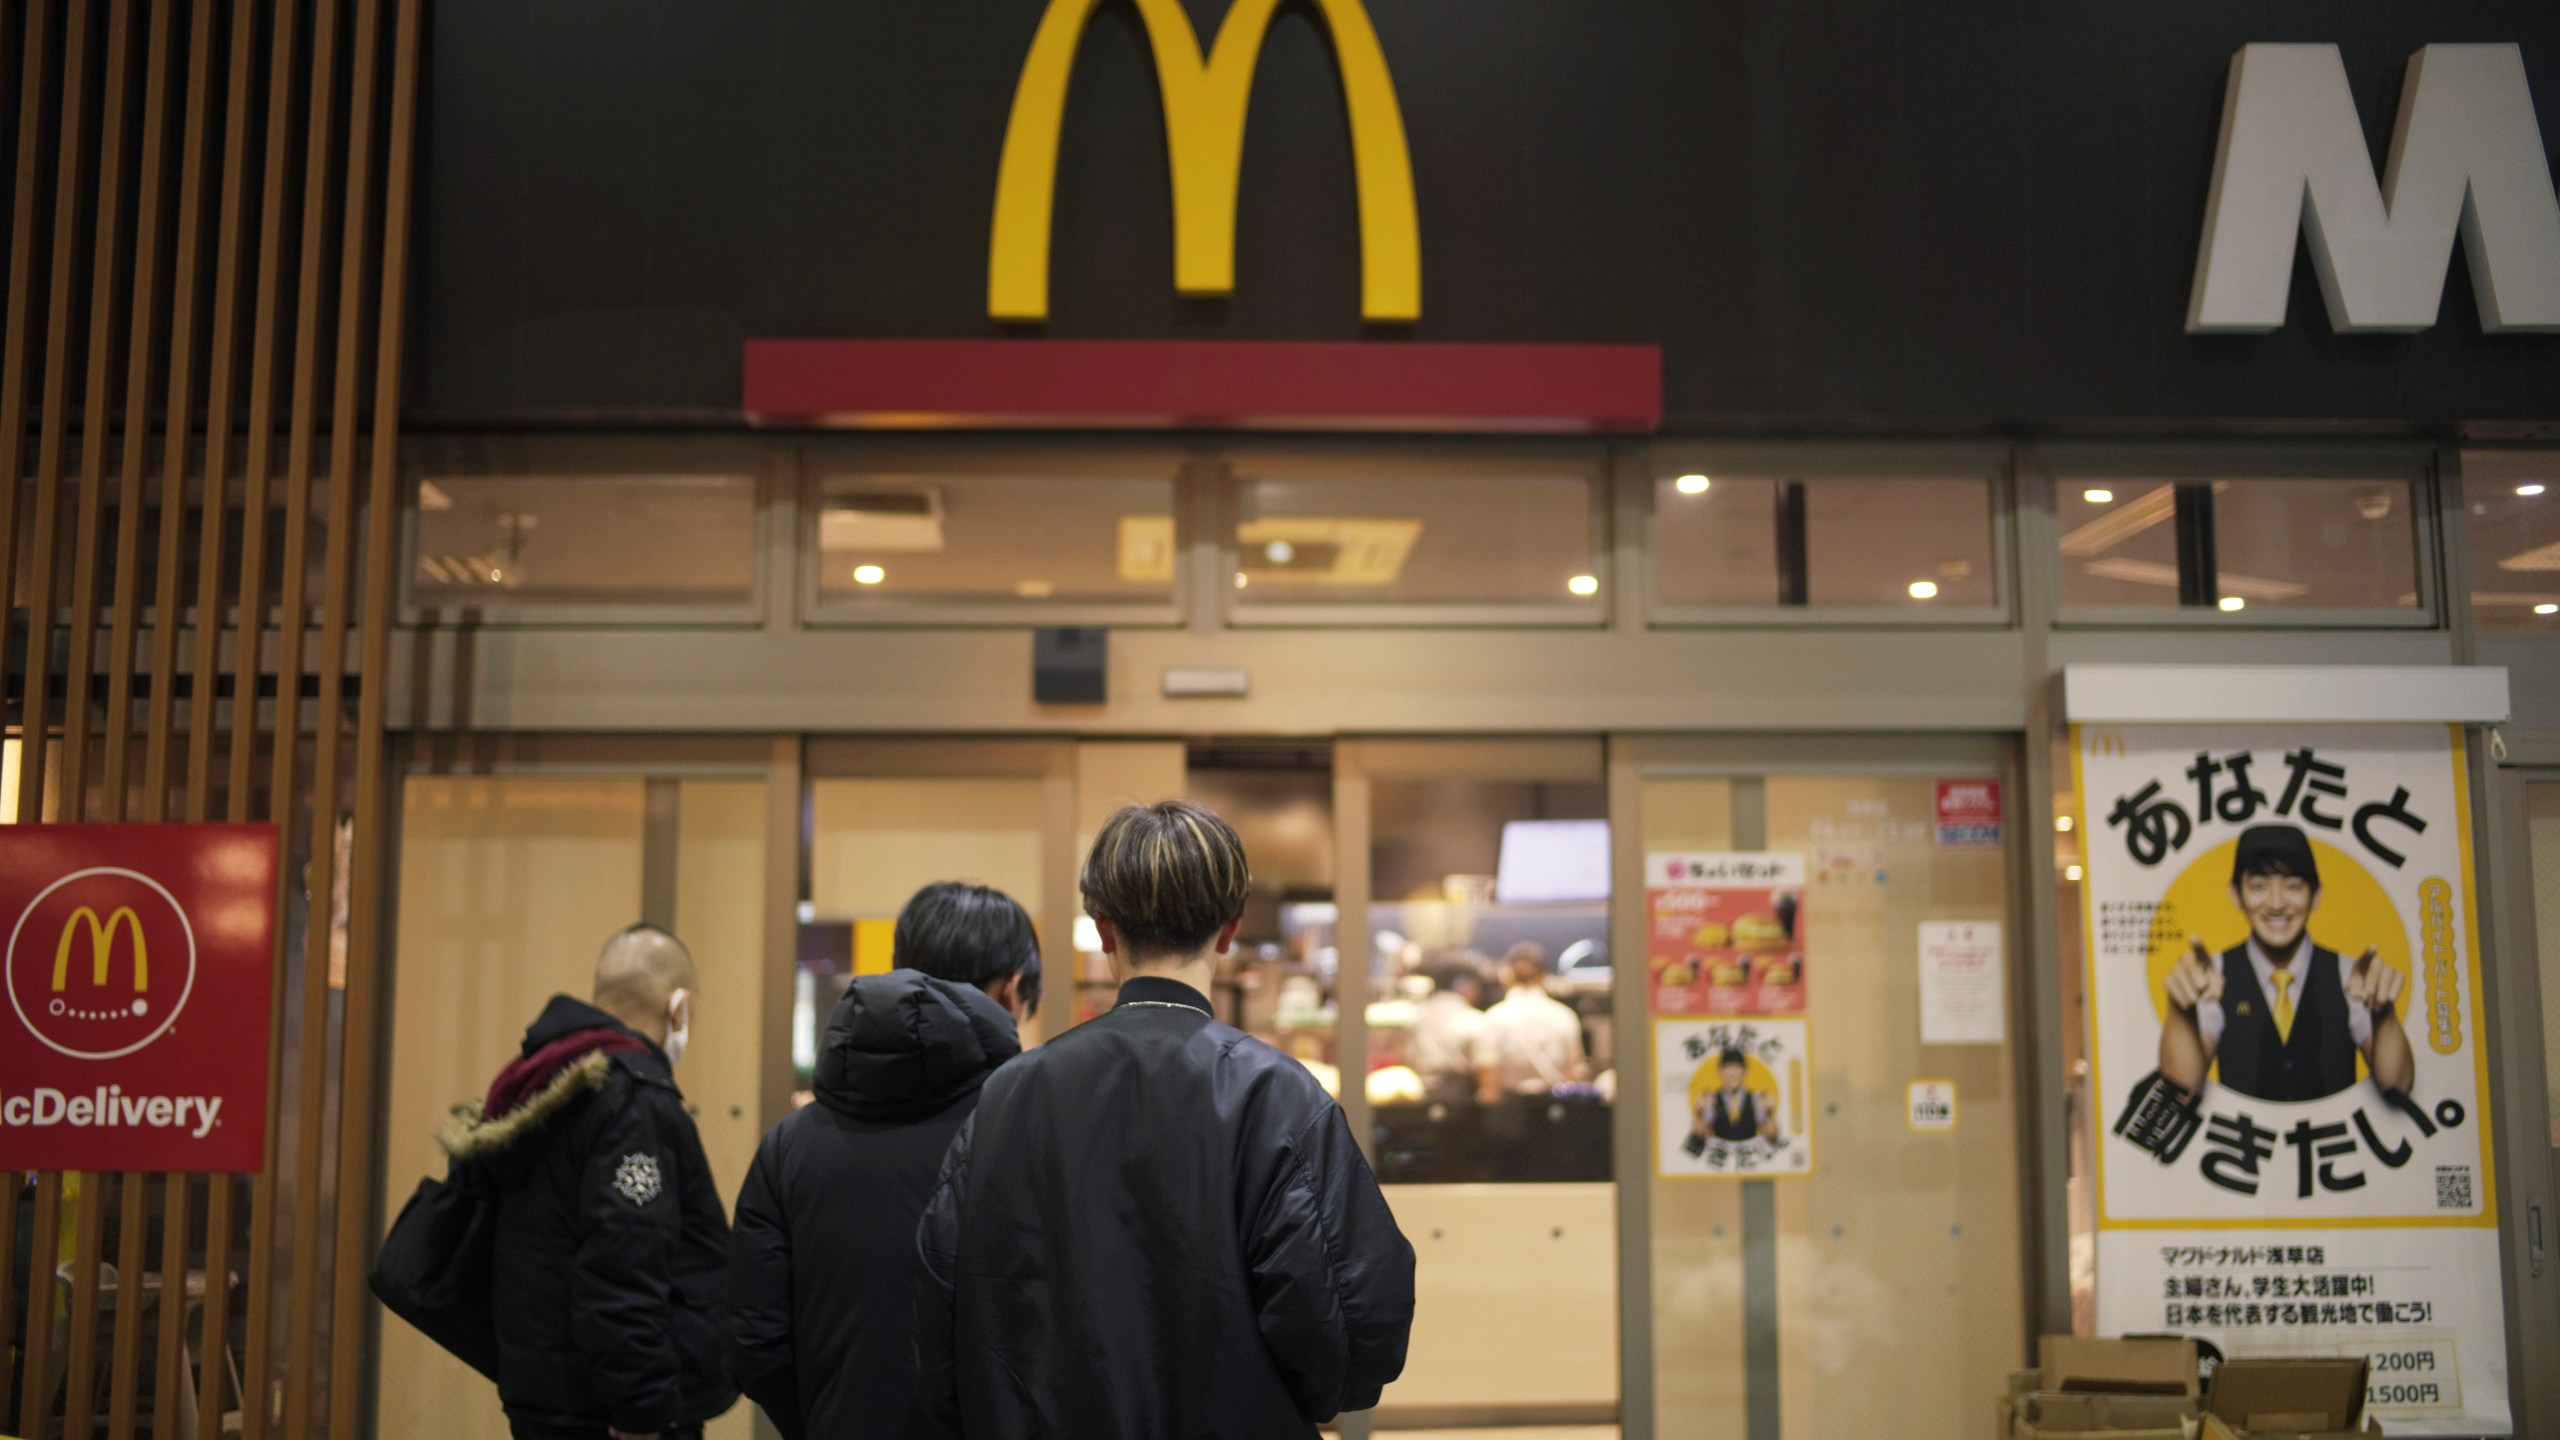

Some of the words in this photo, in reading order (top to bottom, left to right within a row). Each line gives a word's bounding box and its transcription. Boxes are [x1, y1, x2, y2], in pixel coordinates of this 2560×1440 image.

[2106, 745, 2428, 870] あなたと
[0, 1084, 223, 1138] cDelivery
[2112, 1068, 2465, 1198] 働きたい。
[2161, 1246, 2325, 1266] マクドナルド浅草店
[2367, 1384, 2439, 1404] 1500円
